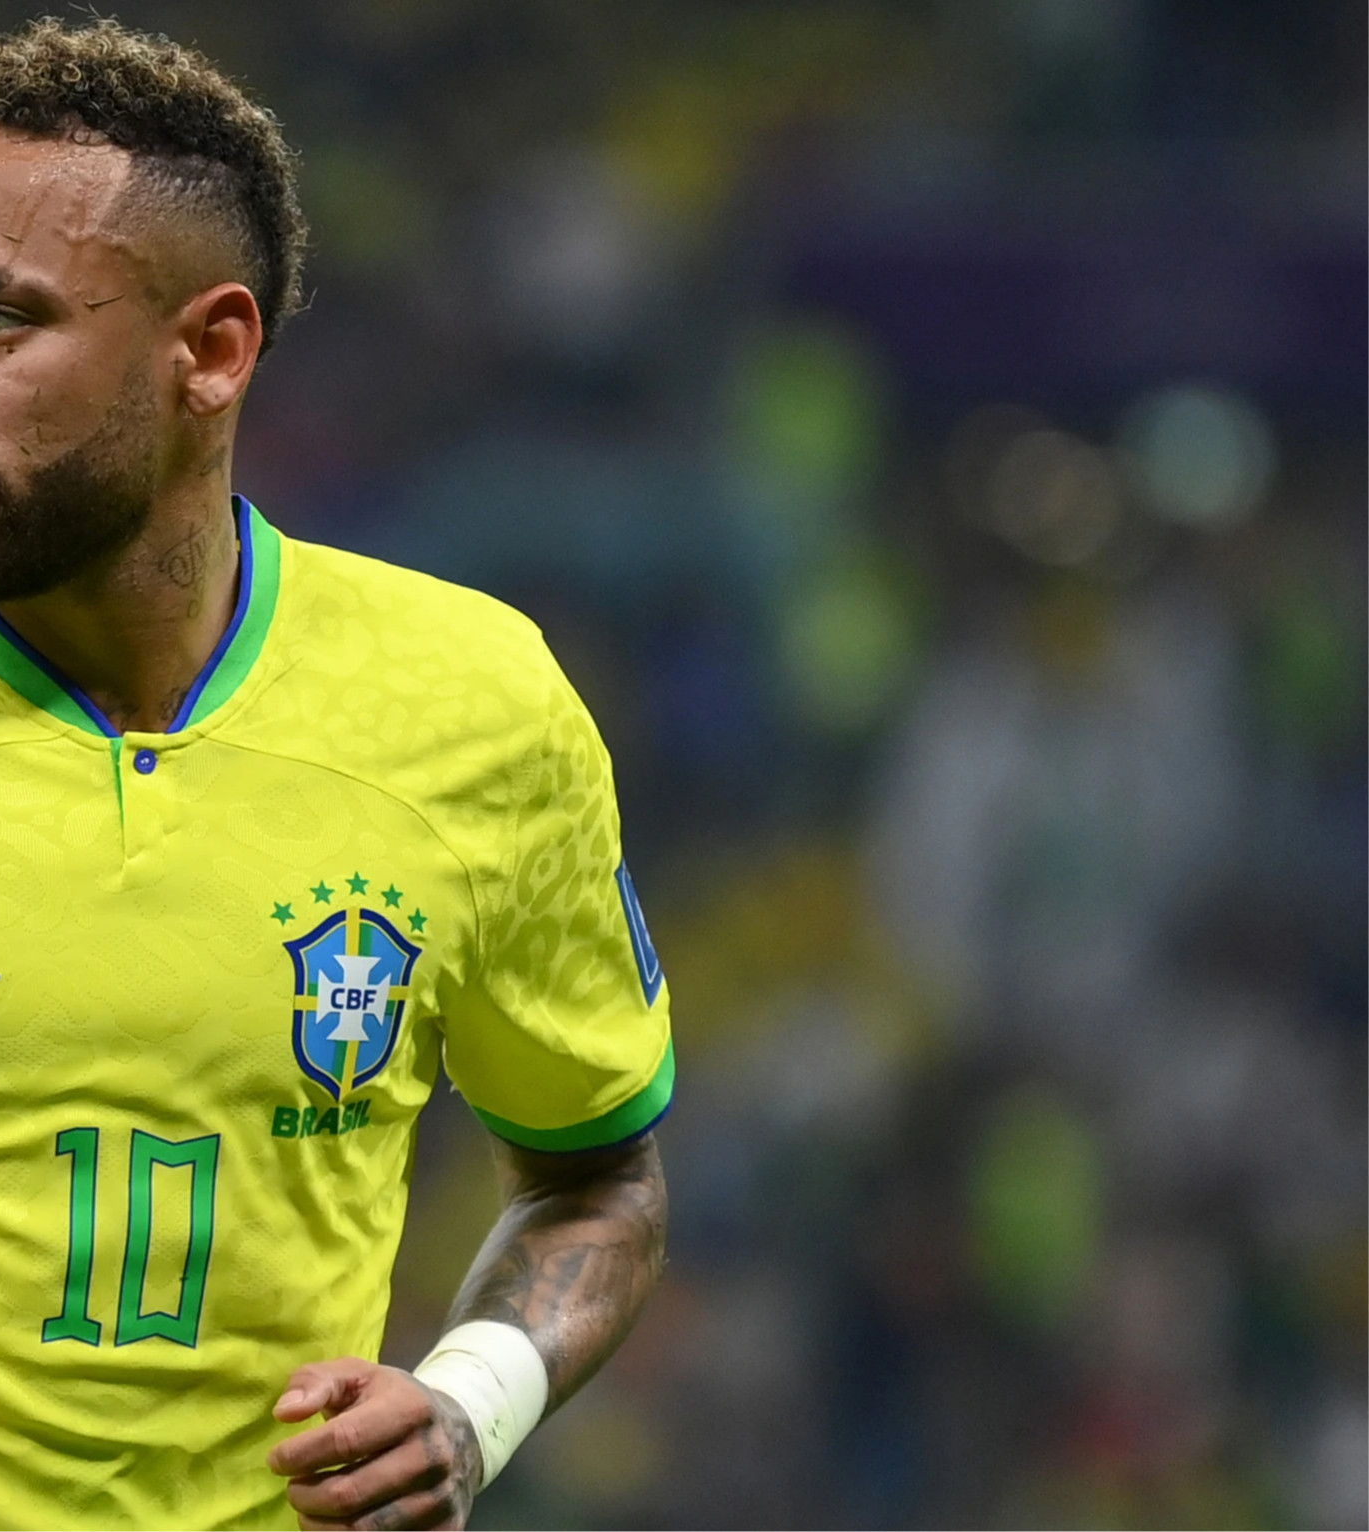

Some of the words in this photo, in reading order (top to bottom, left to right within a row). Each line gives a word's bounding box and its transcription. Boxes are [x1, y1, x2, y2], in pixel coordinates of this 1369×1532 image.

[330, 987, 378, 1011] CBF
[271, 1099, 372, 1139] BRASIL
[41, 1126, 222, 1350] 10
